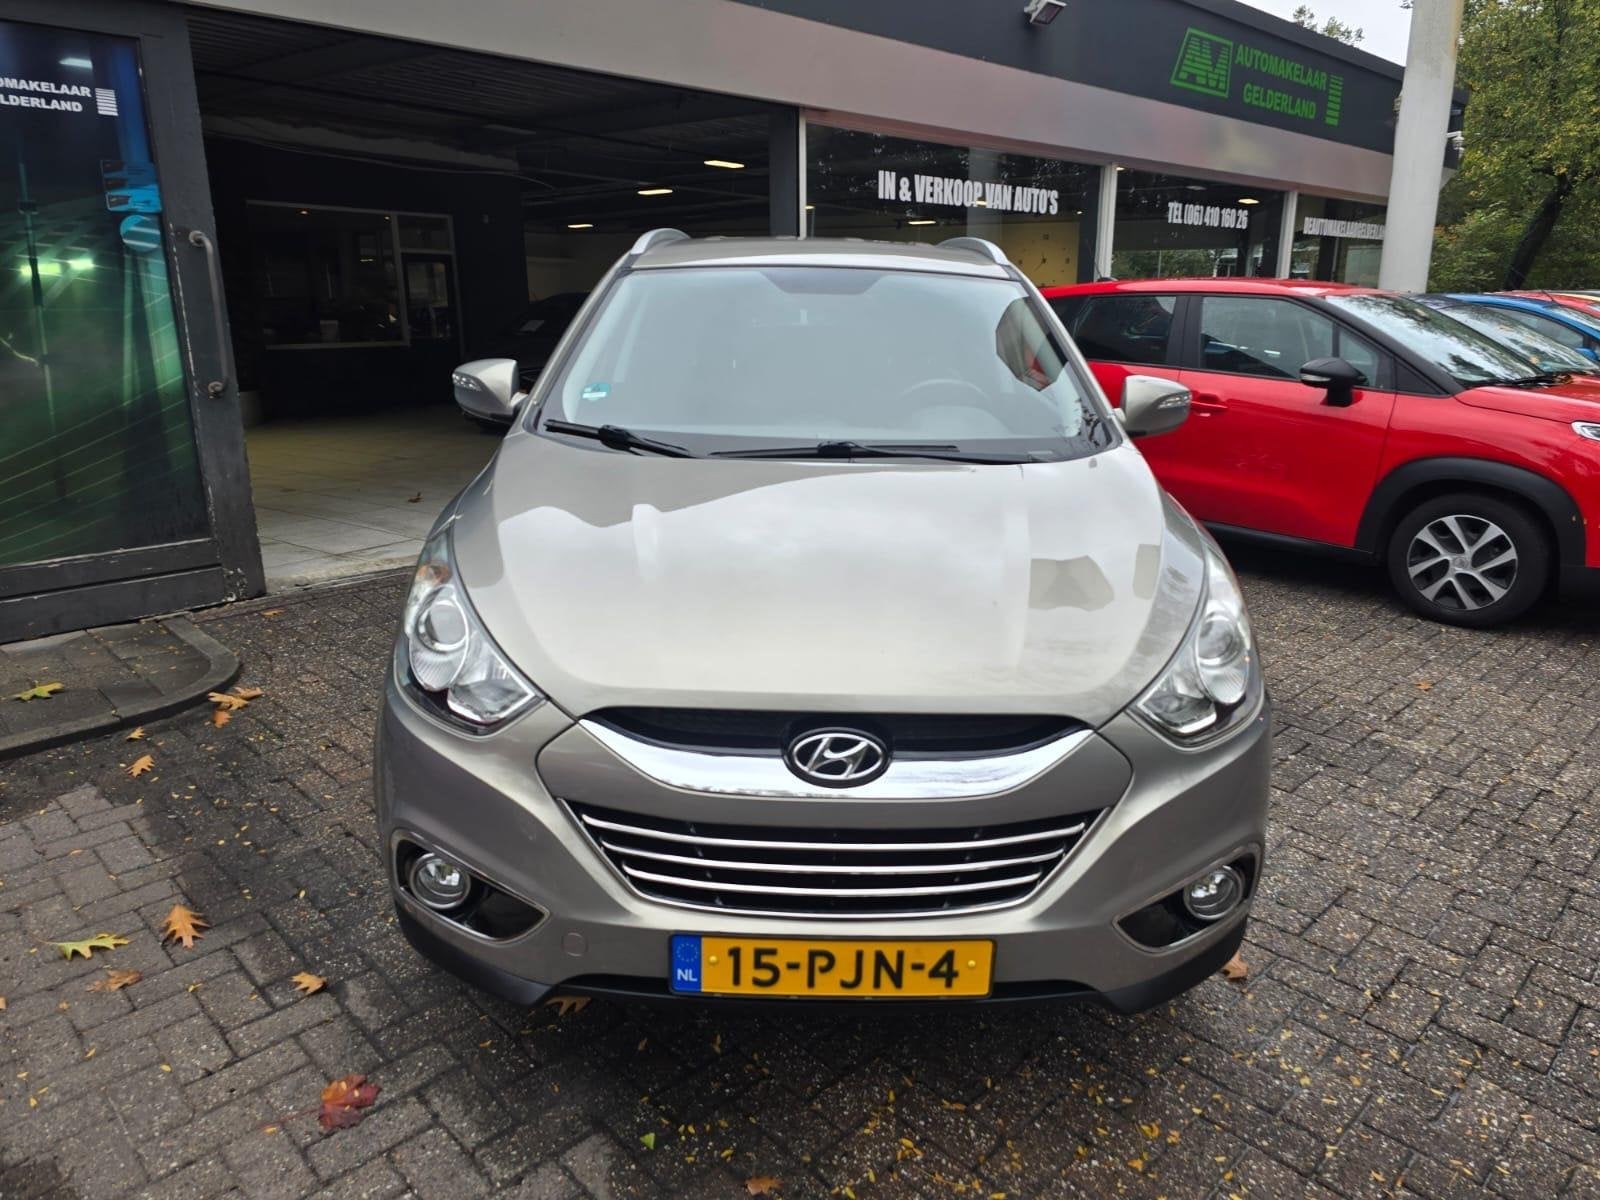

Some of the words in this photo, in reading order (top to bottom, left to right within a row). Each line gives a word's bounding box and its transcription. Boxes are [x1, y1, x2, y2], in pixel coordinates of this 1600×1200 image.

[1235, 44, 1328, 91] AUTOMAKELAAR
[1243, 82, 1316, 119] GELDERLAND
[878, 170, 896, 200] IN
[899, 177, 912, 202] &
[914, 174, 985, 207] VERKOOP
[985, 182, 1014, 211] VAN
[1014, 186, 1059, 215] AUTO'S
[1168, 201, 1183, 224] TEL
[1204, 206, 1220, 227] 410
[1236, 208, 1249, 229] 26
[677, 968, 698, 982] NL
[727, 946, 960, 989] 15-PJN-4
